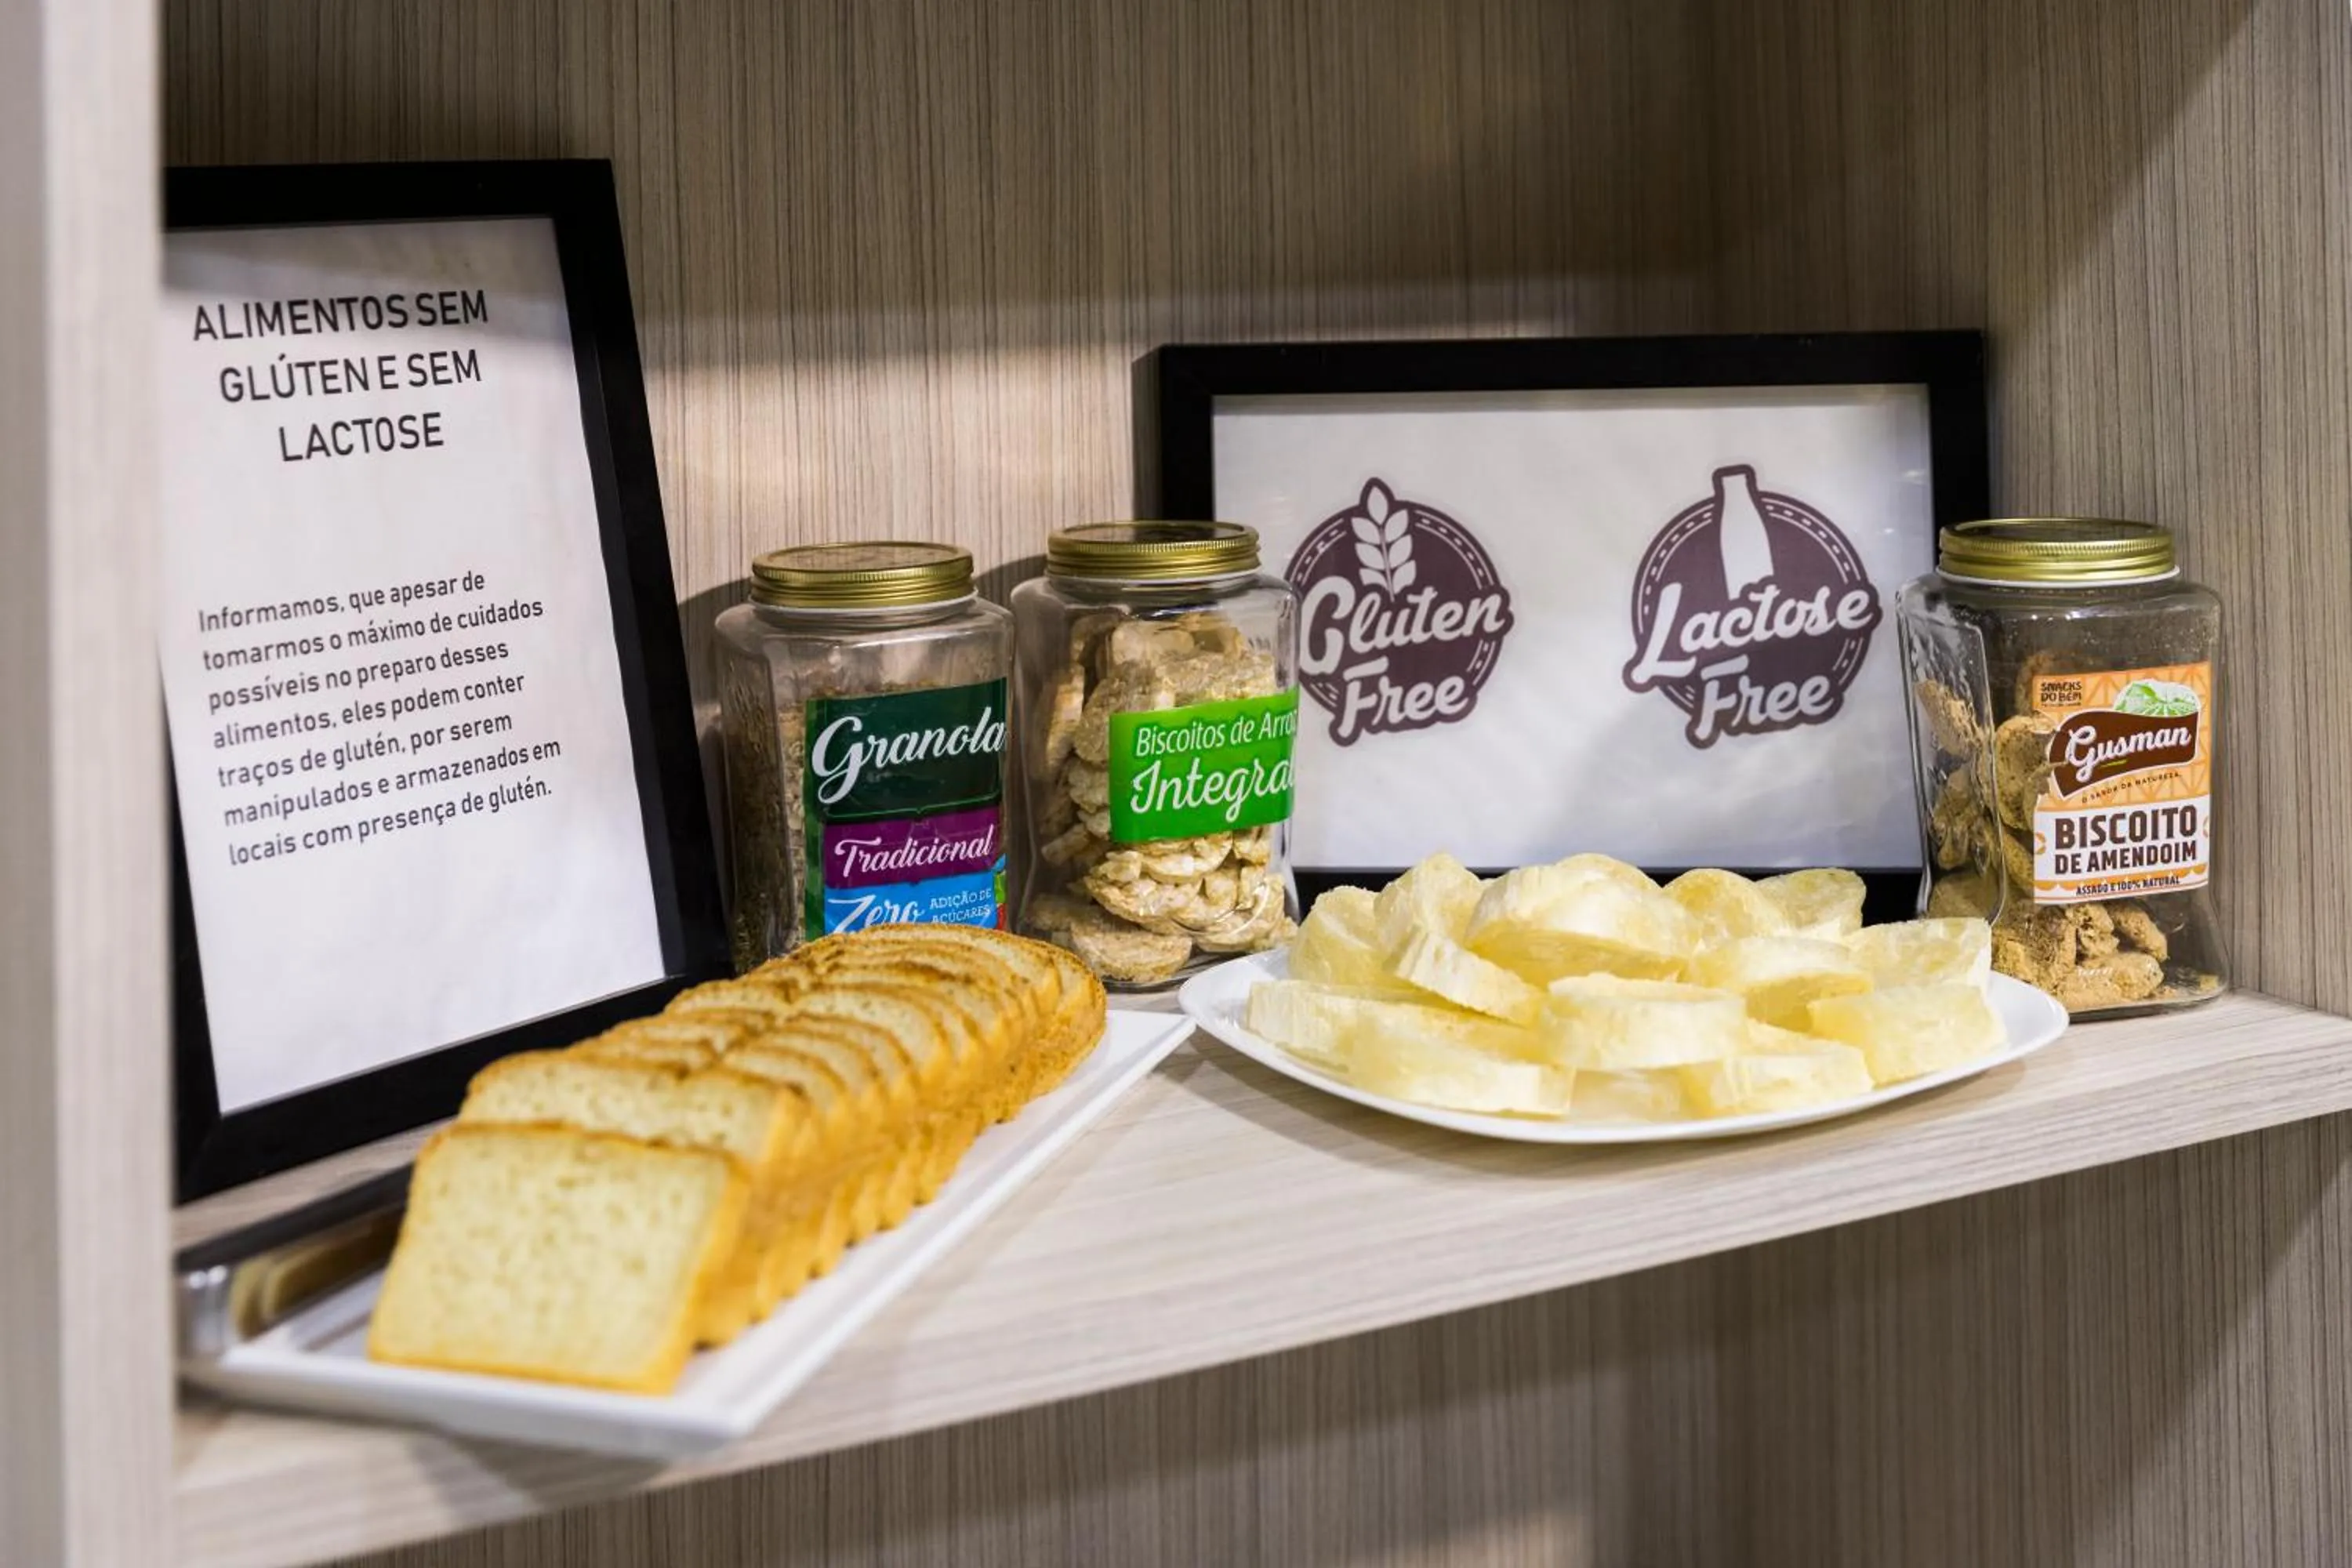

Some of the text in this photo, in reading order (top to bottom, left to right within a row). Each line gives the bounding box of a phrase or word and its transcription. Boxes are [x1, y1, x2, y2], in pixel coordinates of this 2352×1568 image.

[193, 289, 488, 341] ALIMENTOS SEM
[220, 349, 481, 403] GLÚTEN E SEM
[279, 412, 444, 462] LACTOSE
[198, 570, 485, 632] Informamos, que apesar de
[1299, 576, 1506, 676] Gluten
[203, 598, 543, 670] tomarmos o máximo de cuidados
[1631, 583, 1874, 684] Lactose
[209, 641, 510, 715] possíveis no preparo desses
[1338, 657, 1469, 737] Free
[1694, 655, 1834, 740] Free
[2042, 681, 2082, 691] SNACKS
[2042, 691, 2056, 702] DO
[213, 673, 525, 750] alimentos, eles podem conter
[1135, 721, 1225, 756] Biscoitos
[1230, 716, 1254, 745] de
[218, 713, 514, 788] traços de glutén, por serem
[811, 706, 1007, 804] Granola
[2066, 725, 2190, 782] Gusman
[224, 739, 561, 827] manipulados e armazenados em
[230, 776, 552, 866] locais com presença de glutén.
[2055, 804, 2198, 851] BISCOITO
[834, 824, 993, 878] Tradicional
[2055, 840, 2197, 874] DE AMENDOIM
[930, 888, 992, 909] ADIÇÃO DE
[2076, 884, 2107, 895] ASSADO
[2118, 882, 2140, 891] 100%
[2143, 876, 2180, 887] NATURAL
[828, 895, 924, 935] Zero
